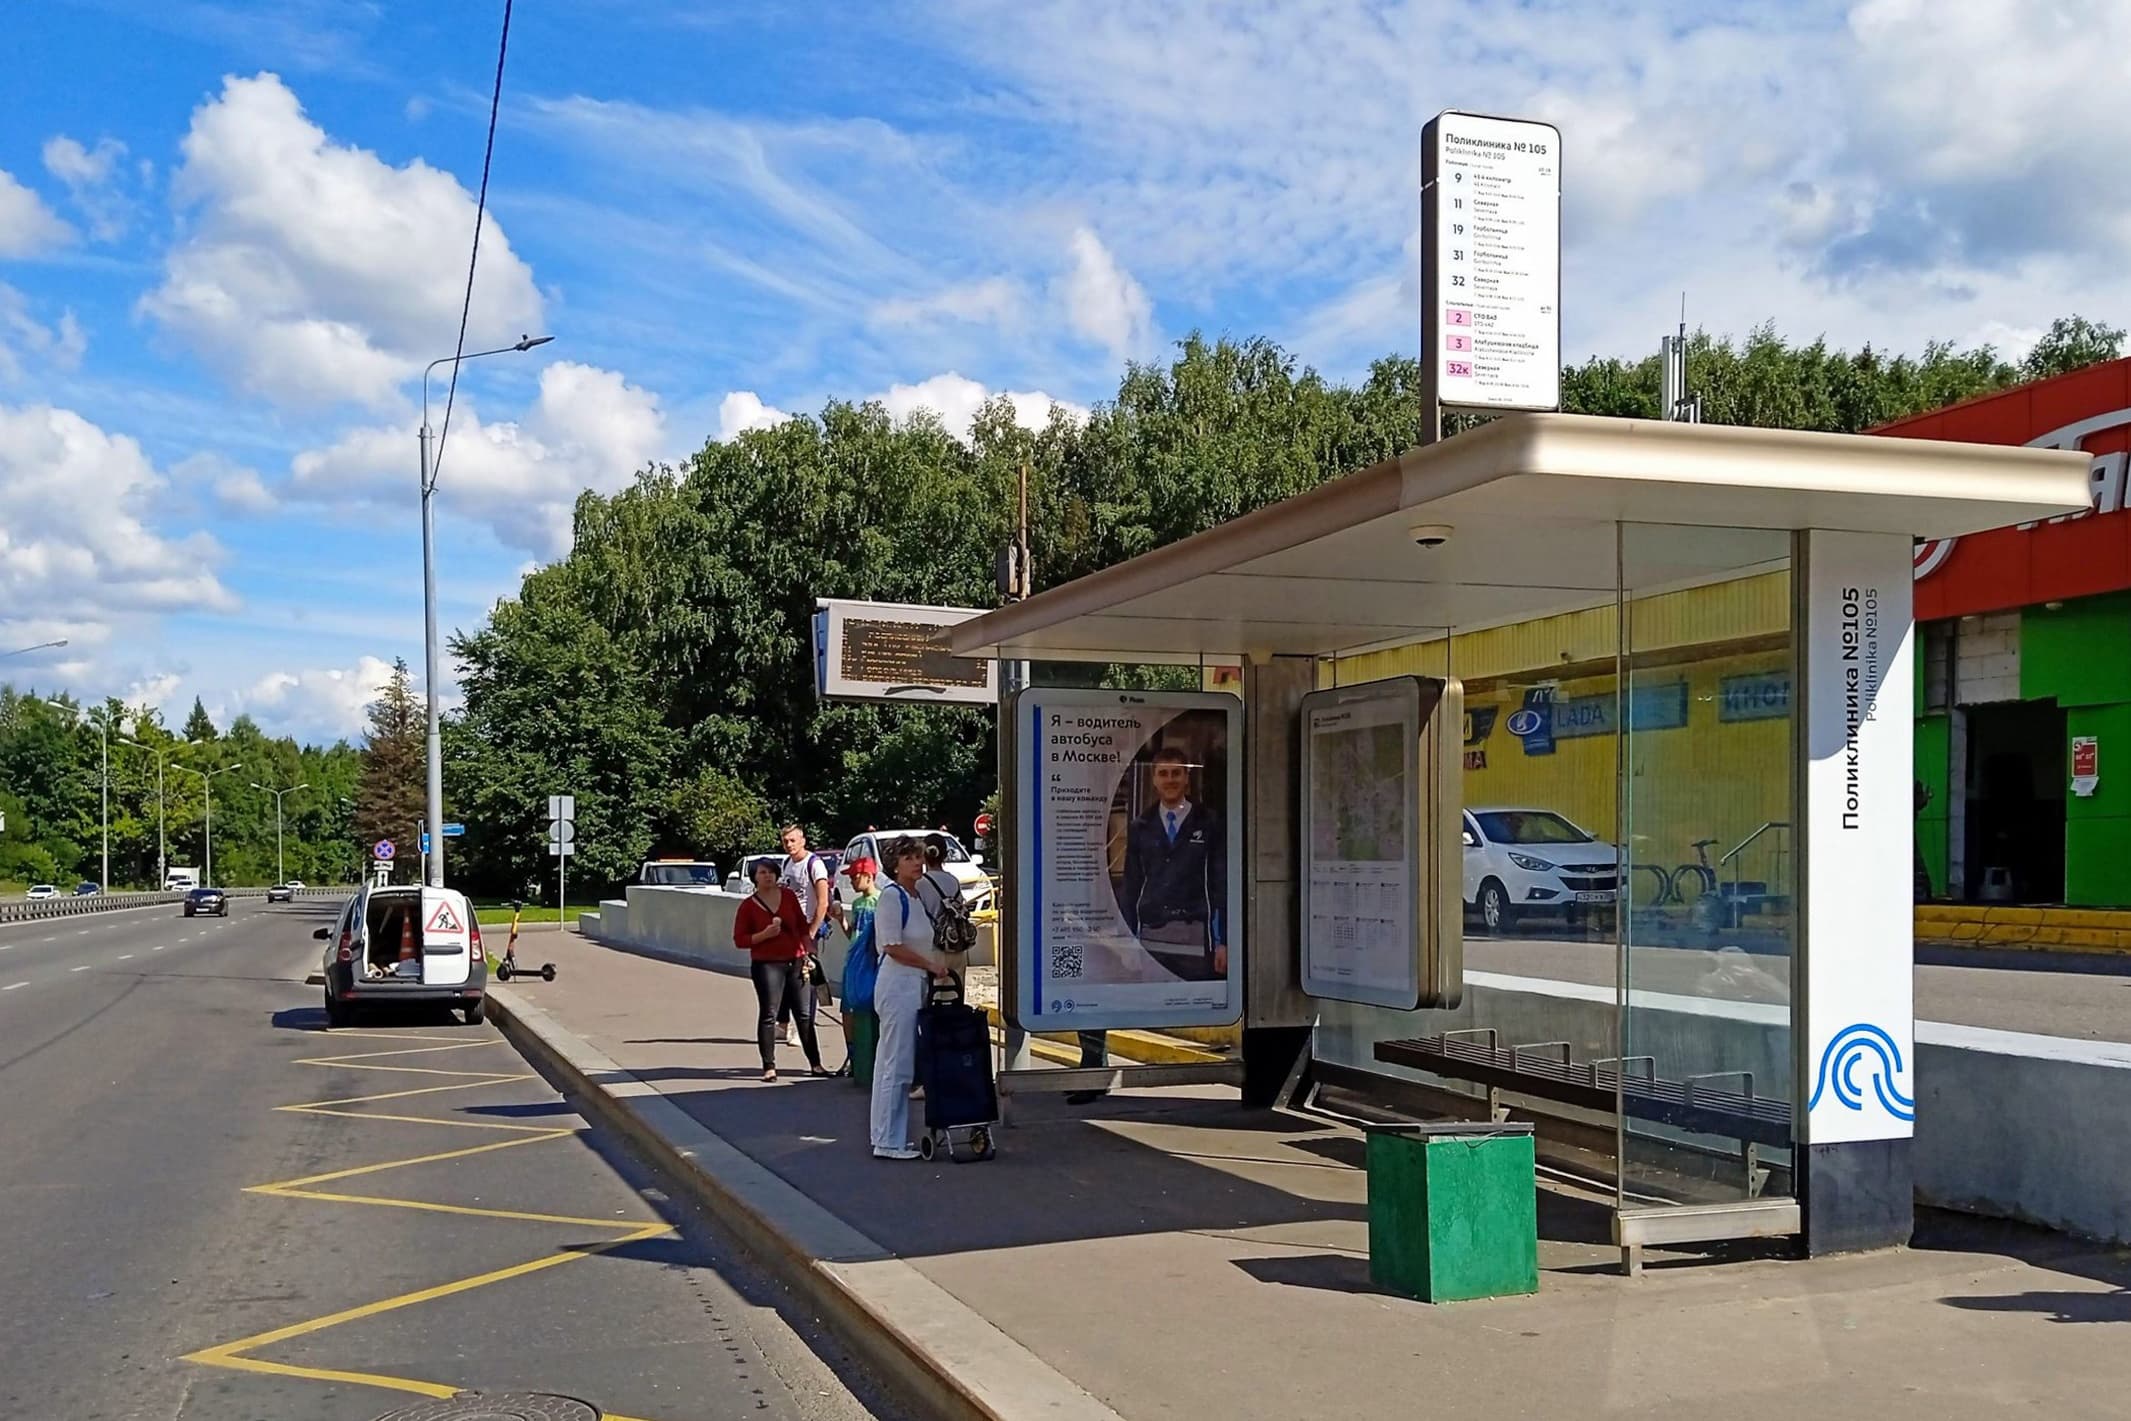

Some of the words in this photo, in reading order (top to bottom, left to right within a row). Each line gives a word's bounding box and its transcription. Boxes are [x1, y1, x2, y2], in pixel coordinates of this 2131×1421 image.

[1446, 133, 1512, 151] Поликлиника
[1514, 141, 1526, 153] №
[1529, 143, 1547, 155] 105
[1493, 152, 1506, 161] 105
[1454, 172, 1463, 183] 9
[1453, 198, 1462, 209] 11
[1453, 224, 1464, 235] 19
[1453, 250, 1464, 261] 31
[1451, 275, 1465, 287] 32
[1455, 313, 1463, 323] 2
[1455, 338, 1463, 349] 3
[1865, 588, 1878, 639] №105
[1843, 587, 1859, 661] №105
[1865, 640, 1878, 722] Poliklinika
[1050, 715, 1061, 727] Я
[1077, 717, 1141, 730] водитель
[1557, 705, 1605, 728] LADA
[1050, 732, 1113, 748] автобуса
[1843, 667, 1859, 829] Поликлиника
[1051, 753, 1059, 762] в
[1062, 751, 1121, 763] Москве!
